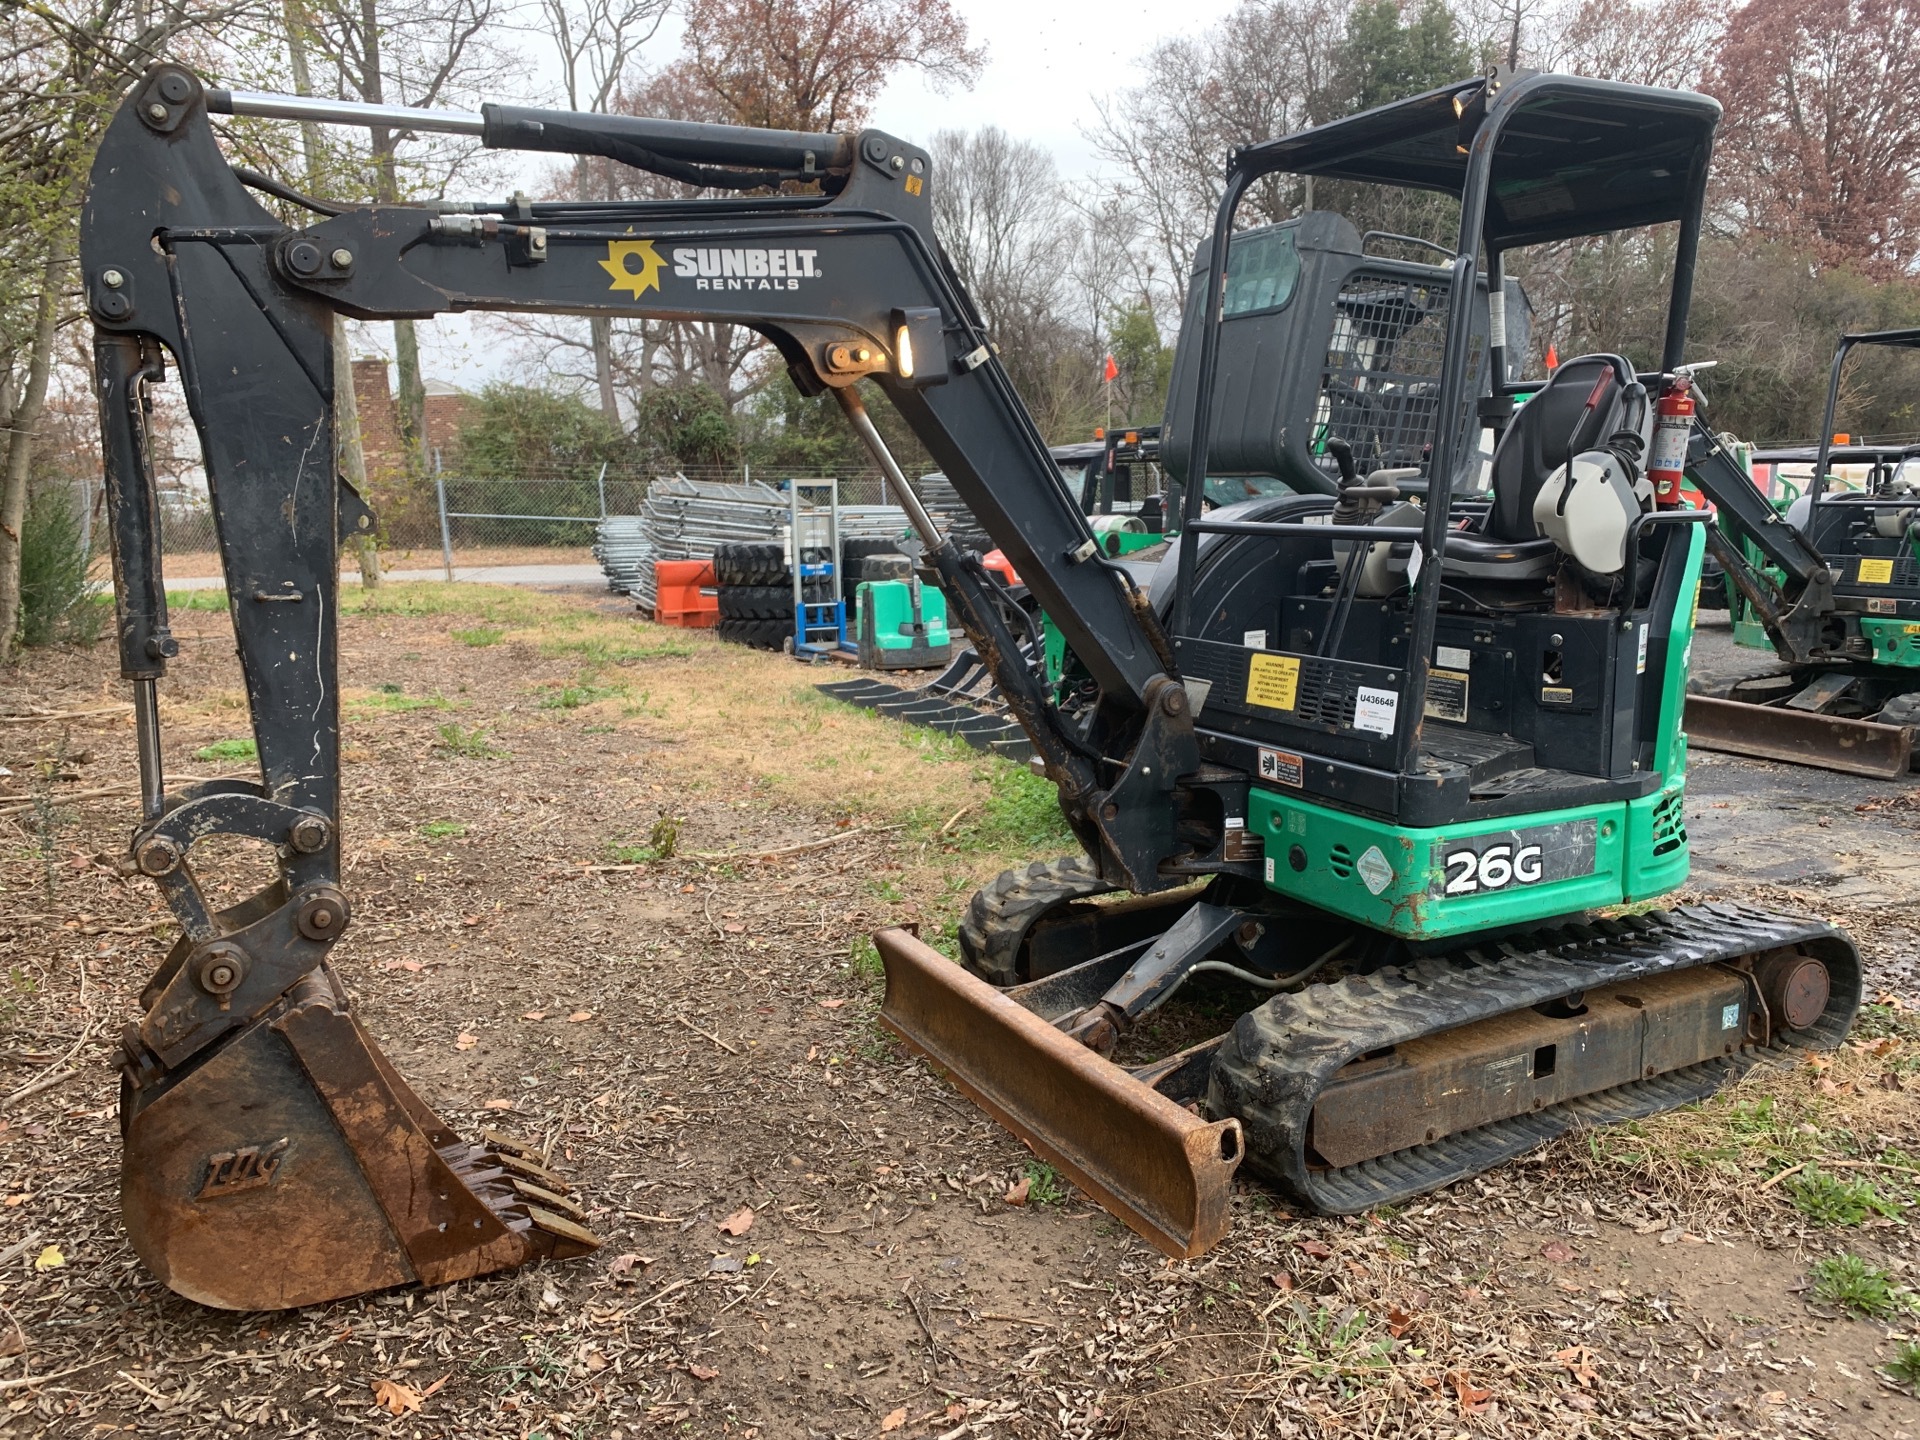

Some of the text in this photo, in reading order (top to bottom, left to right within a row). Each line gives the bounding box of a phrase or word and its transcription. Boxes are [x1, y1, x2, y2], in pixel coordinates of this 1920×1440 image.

[672, 248, 818, 278] SUNBELT
[696, 278, 800, 291] RENTALS
[1360, 693, 1395, 707] U436648
[1445, 844, 1543, 894] 26G
